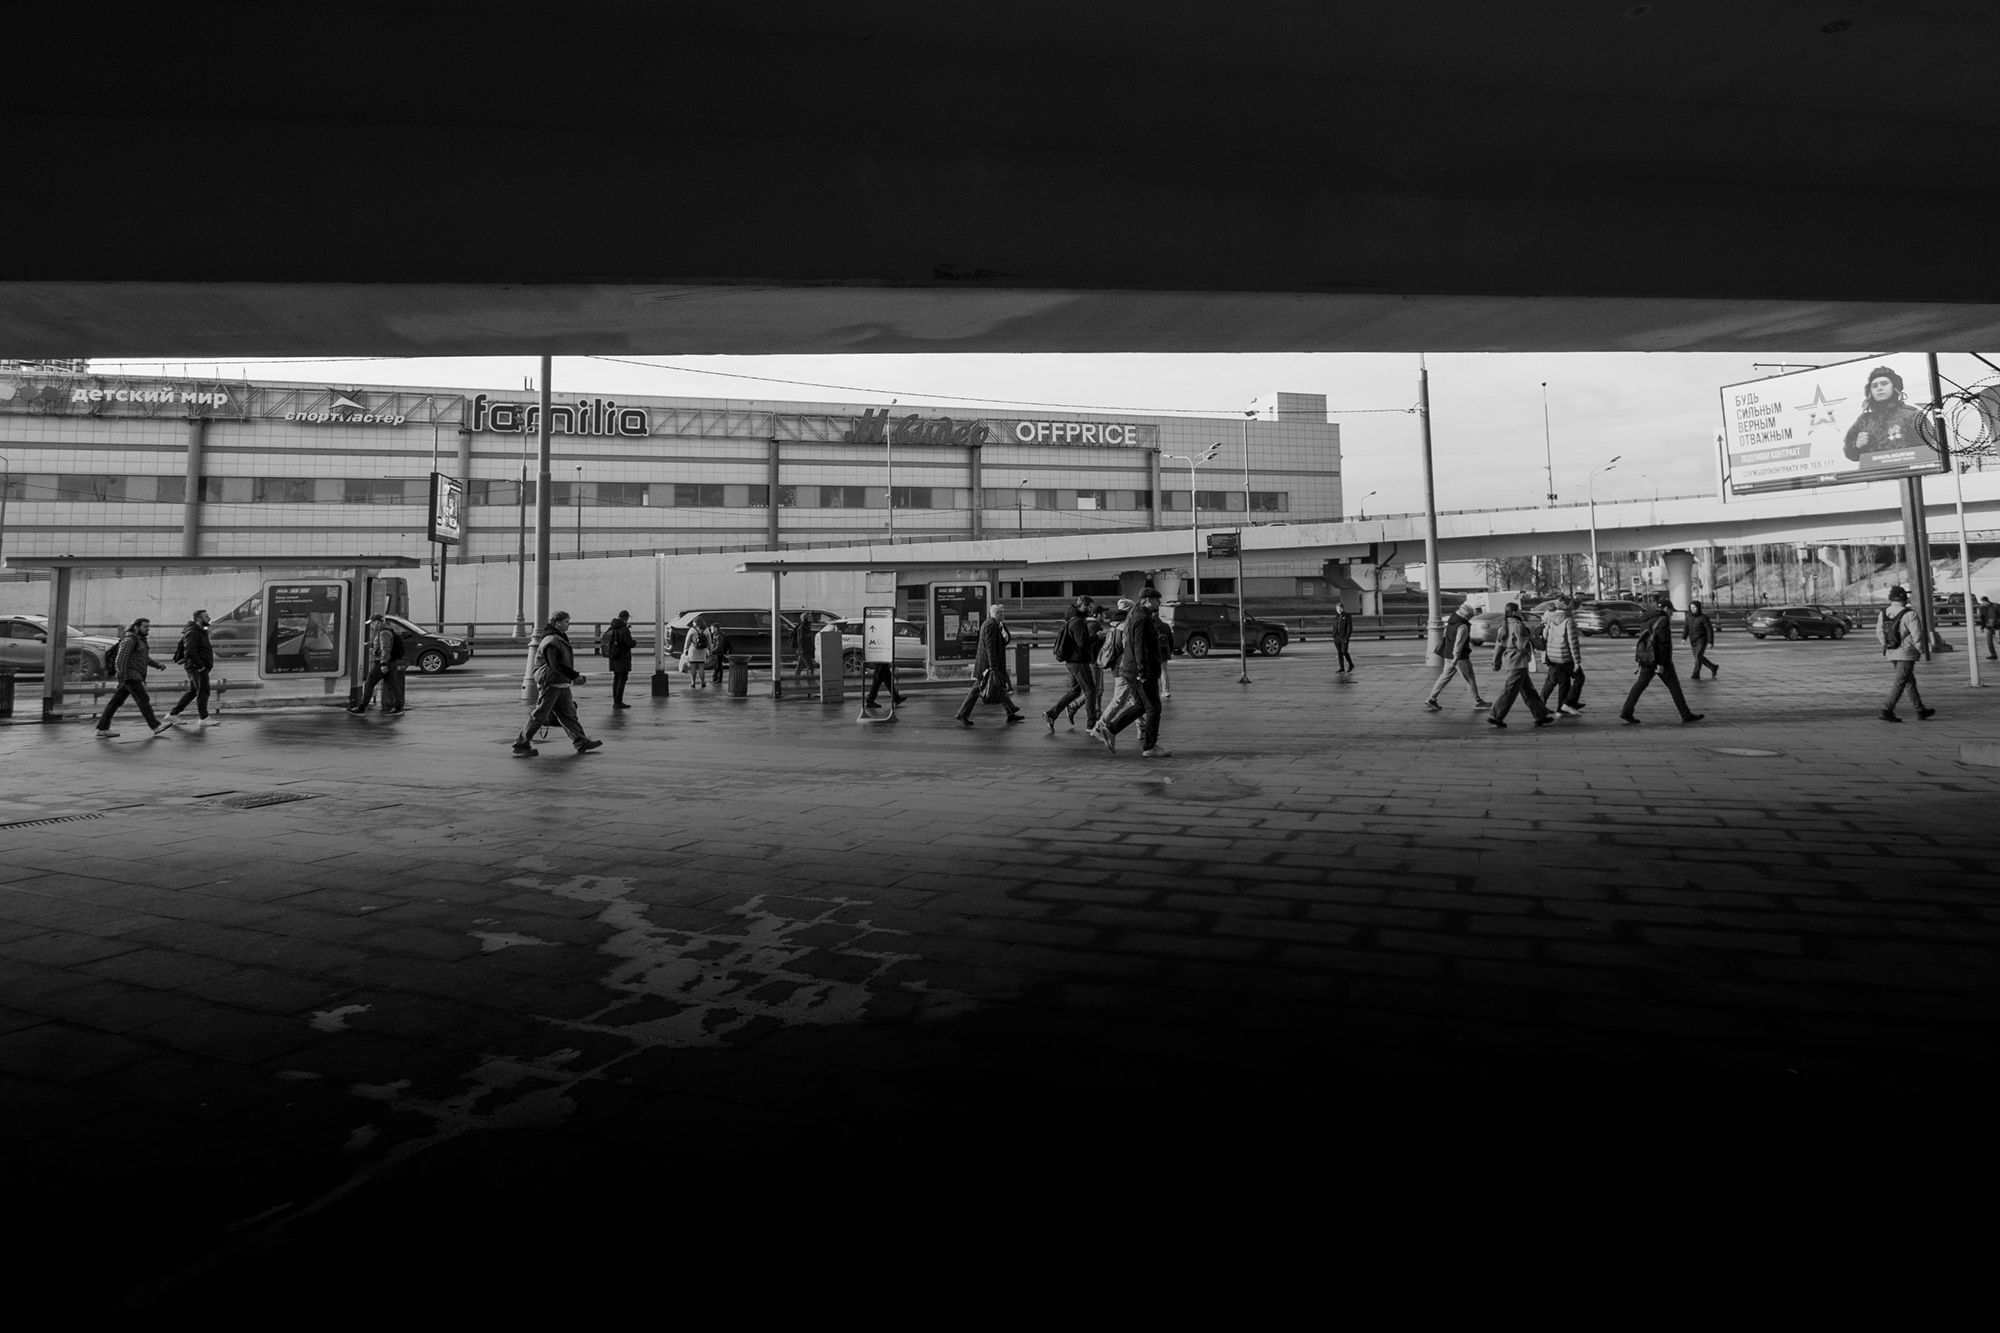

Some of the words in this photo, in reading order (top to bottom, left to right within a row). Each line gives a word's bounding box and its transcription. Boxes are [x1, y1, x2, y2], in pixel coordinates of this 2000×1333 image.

[72, 387, 174, 403] детский
[181, 390, 228, 409] мир
[1735, 392, 1760, 407] БУДЬ
[472, 394, 649, 437] familia
[1736, 402, 1783, 420] СИЛЬНЫМ
[1016, 421, 1137, 445] OFFPRICE
[1737, 416, 1777, 433] ВЕРНЫМ
[1739, 427, 1793, 447] ОТВАЖНЫМ
[1741, 451, 1770, 463] ПОДПИШИ
[1771, 447, 1801, 459] КОНТРАКТ
[1824, 460, 1834, 468] 117
